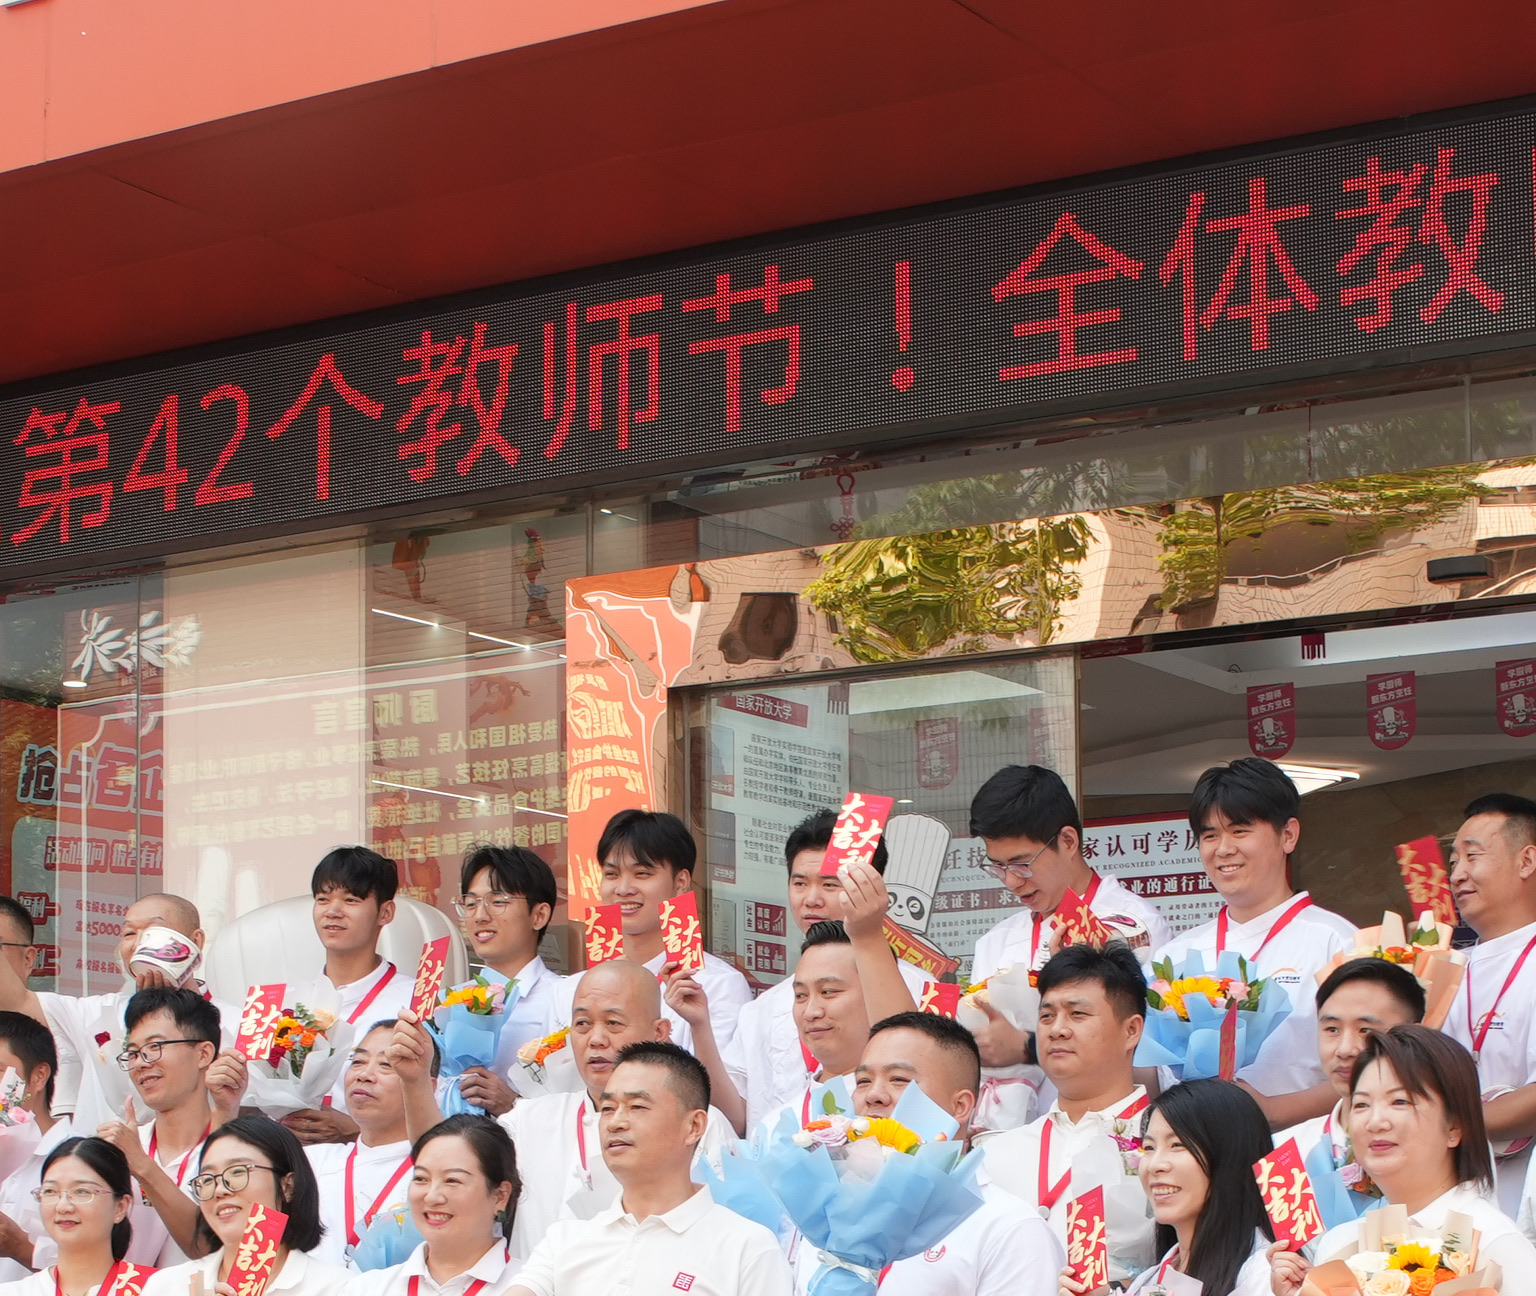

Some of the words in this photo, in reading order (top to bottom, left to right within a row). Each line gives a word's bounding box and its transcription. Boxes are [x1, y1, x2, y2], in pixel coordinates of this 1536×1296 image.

[735, 693, 793, 720] 国家开放大学
[1102, 860, 1156, 871] RECOGNIZED
[940, 874, 986, 884] ECHNIQUES
